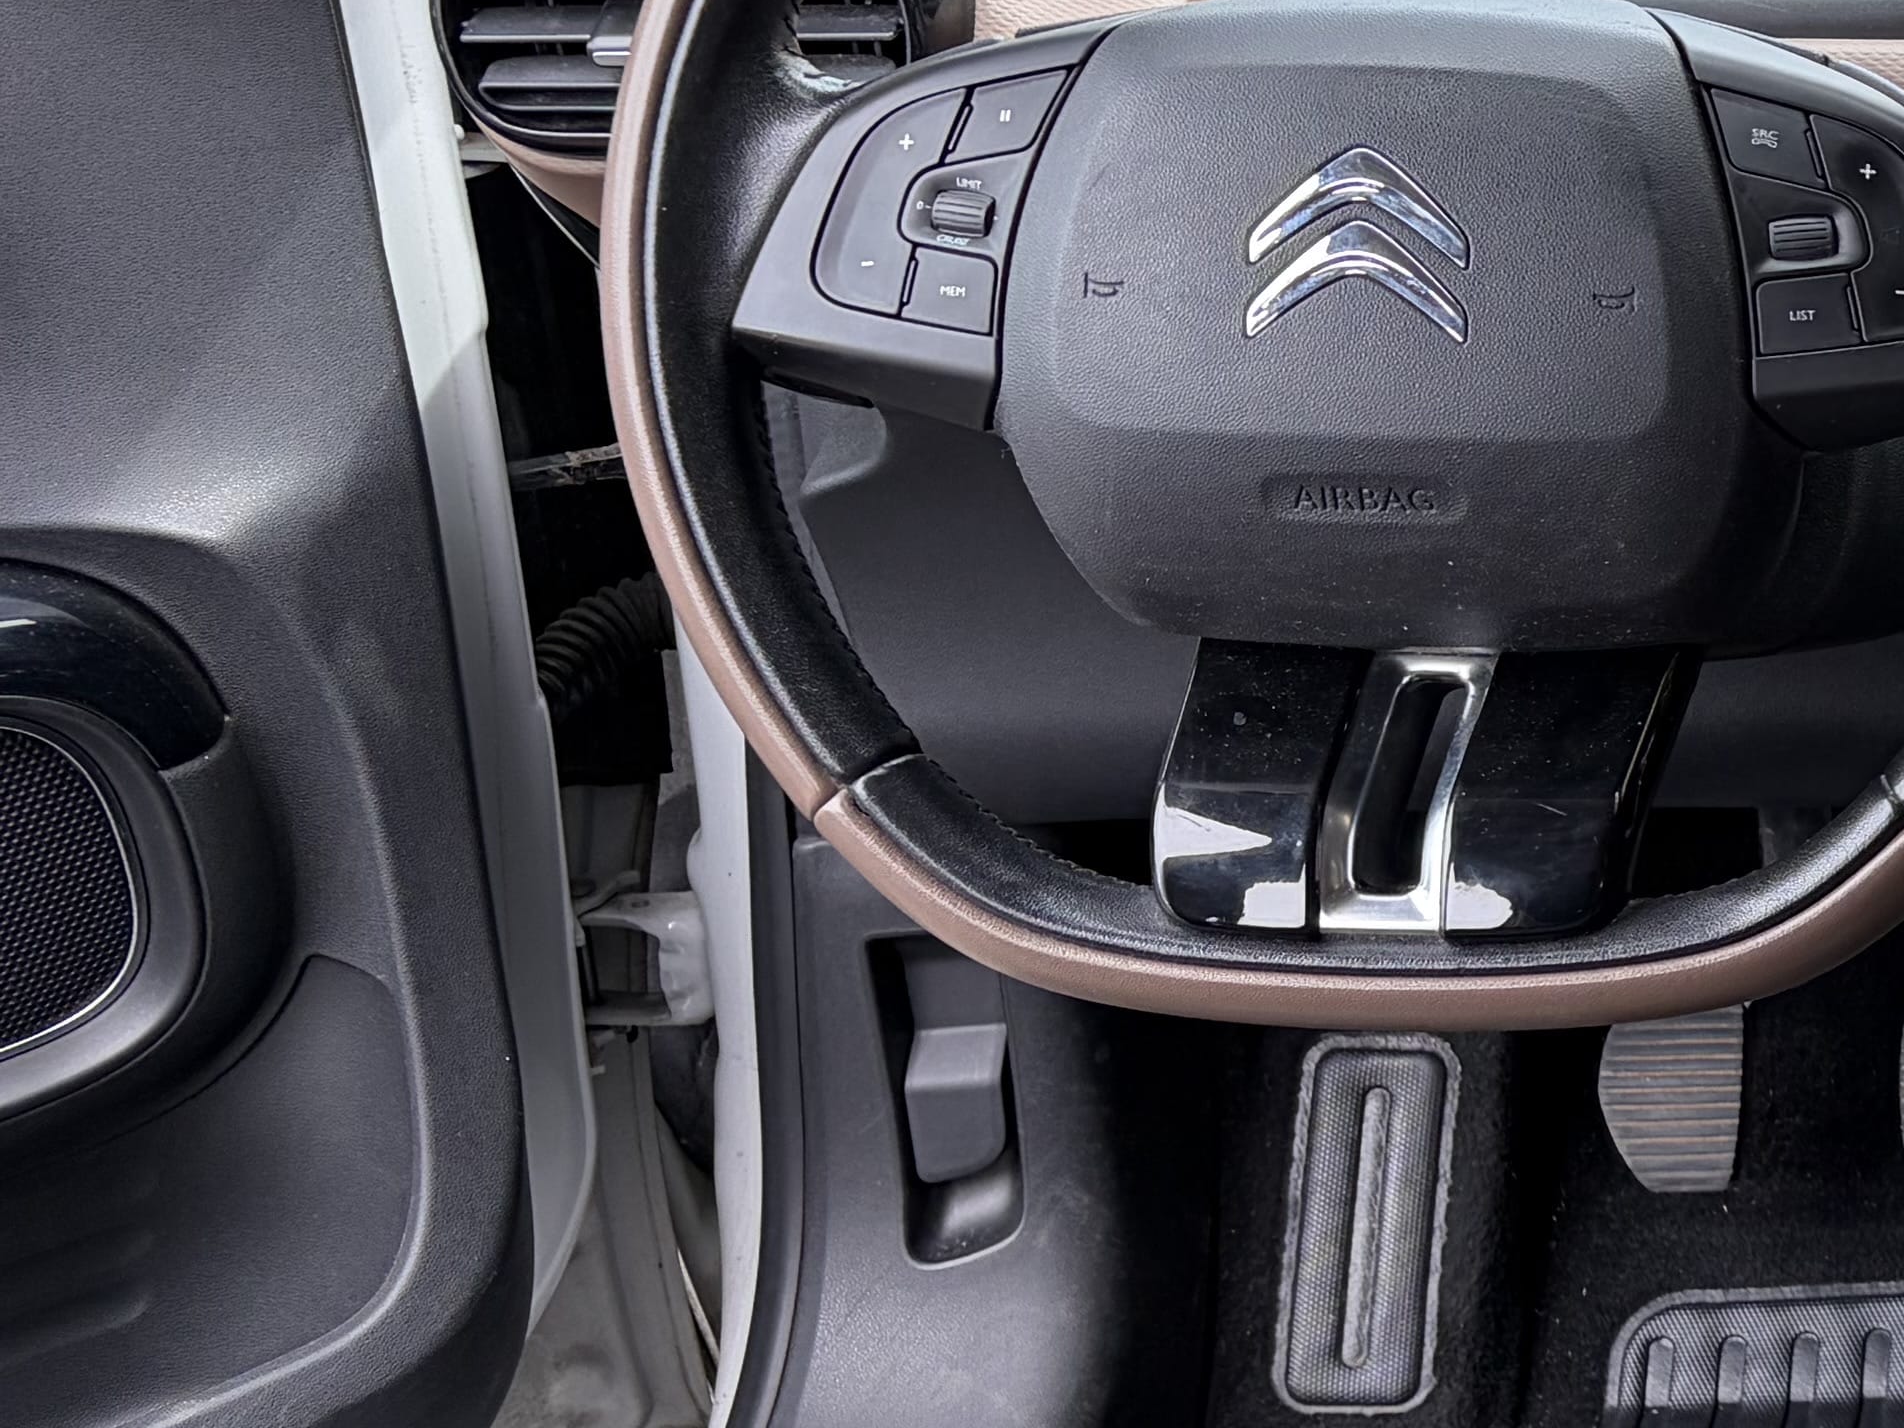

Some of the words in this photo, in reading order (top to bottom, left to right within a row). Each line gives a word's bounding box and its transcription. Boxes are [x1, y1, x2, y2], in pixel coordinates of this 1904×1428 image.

[1751, 128, 1780, 141] SRC
[956, 176, 982, 190] LIMIT
[939, 284, 966, 298] MEM
[1789, 309, 1816, 322] LIST
[1294, 483, 1436, 513] AIRBAG
